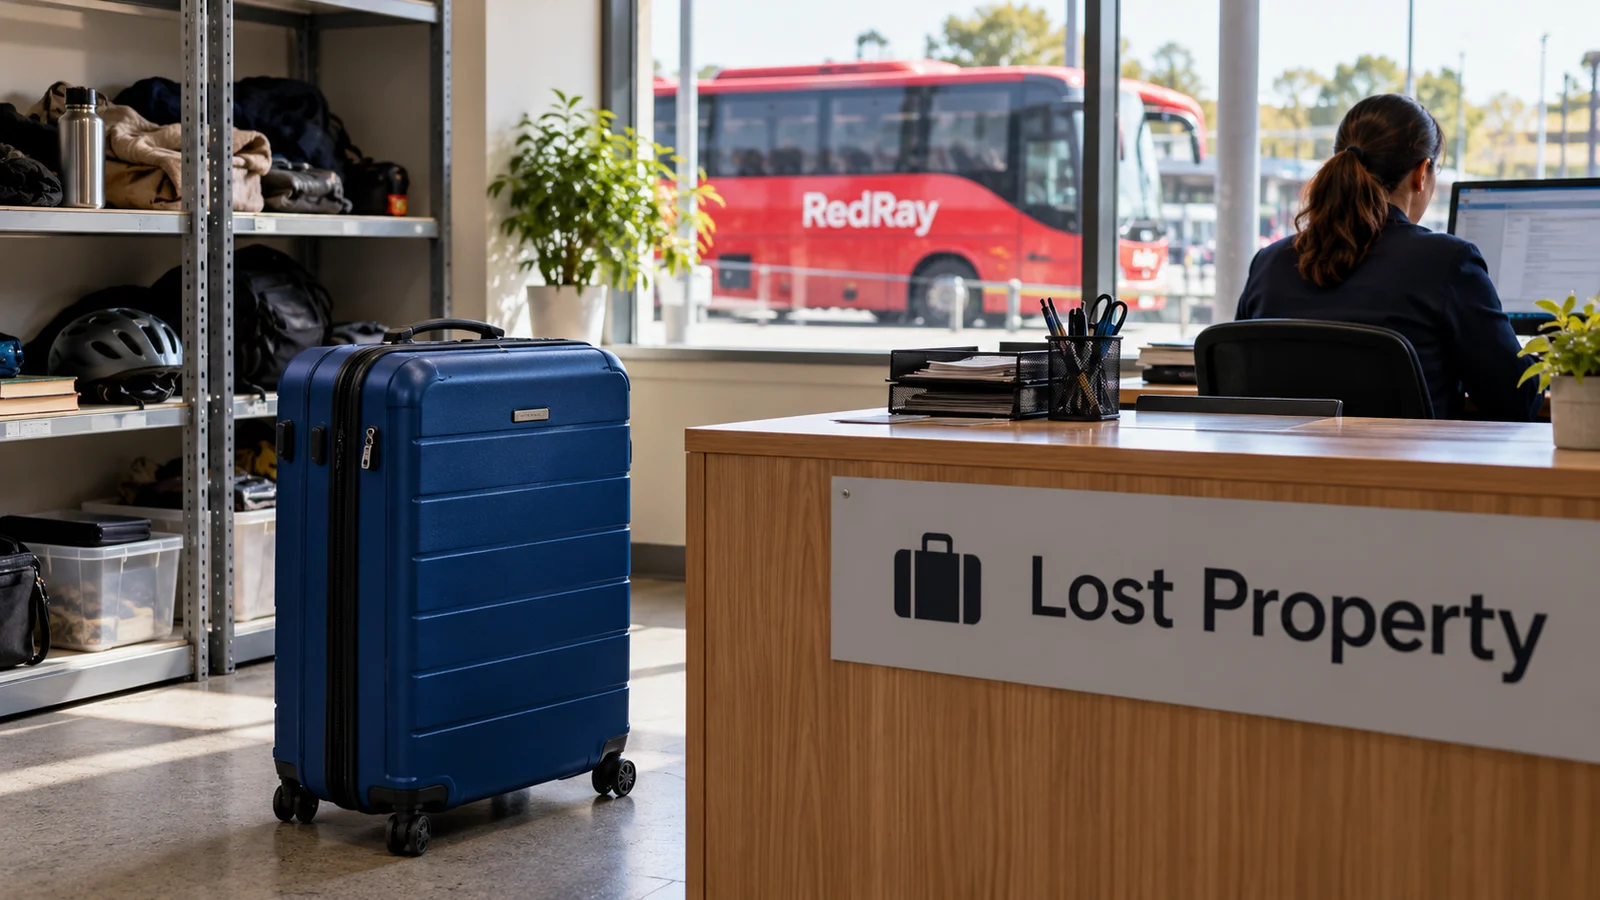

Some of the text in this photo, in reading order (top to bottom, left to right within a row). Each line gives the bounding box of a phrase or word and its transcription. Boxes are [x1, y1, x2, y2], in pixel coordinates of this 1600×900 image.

[802, 190, 940, 237] RedRay
[1031, 554, 1549, 685] Lost Property
